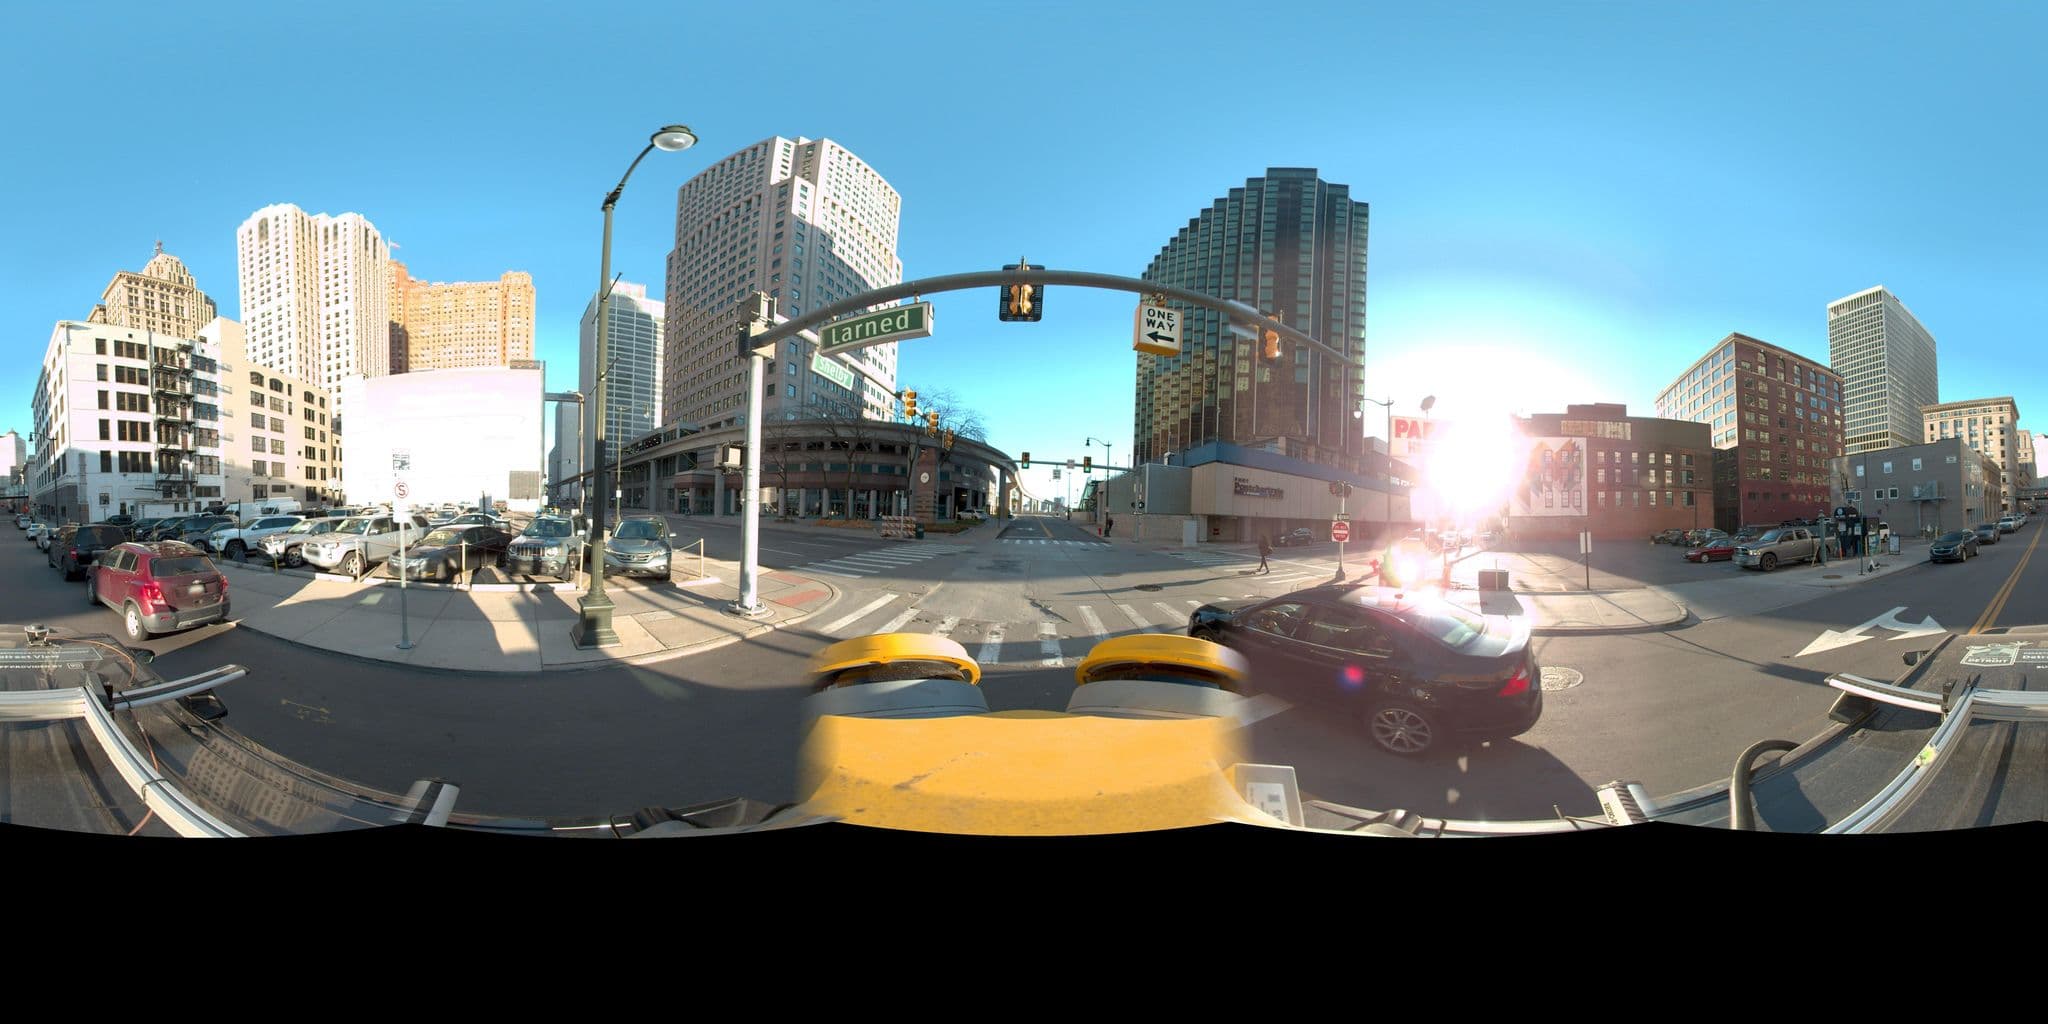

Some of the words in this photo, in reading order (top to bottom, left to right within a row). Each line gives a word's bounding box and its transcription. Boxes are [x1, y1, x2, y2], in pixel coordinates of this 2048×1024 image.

[1146, 318, 1175, 332] WAY
[1147, 308, 1174, 322] ONE
[831, 310, 909, 345] Larned
[818, 357, 849, 384] Shelby
